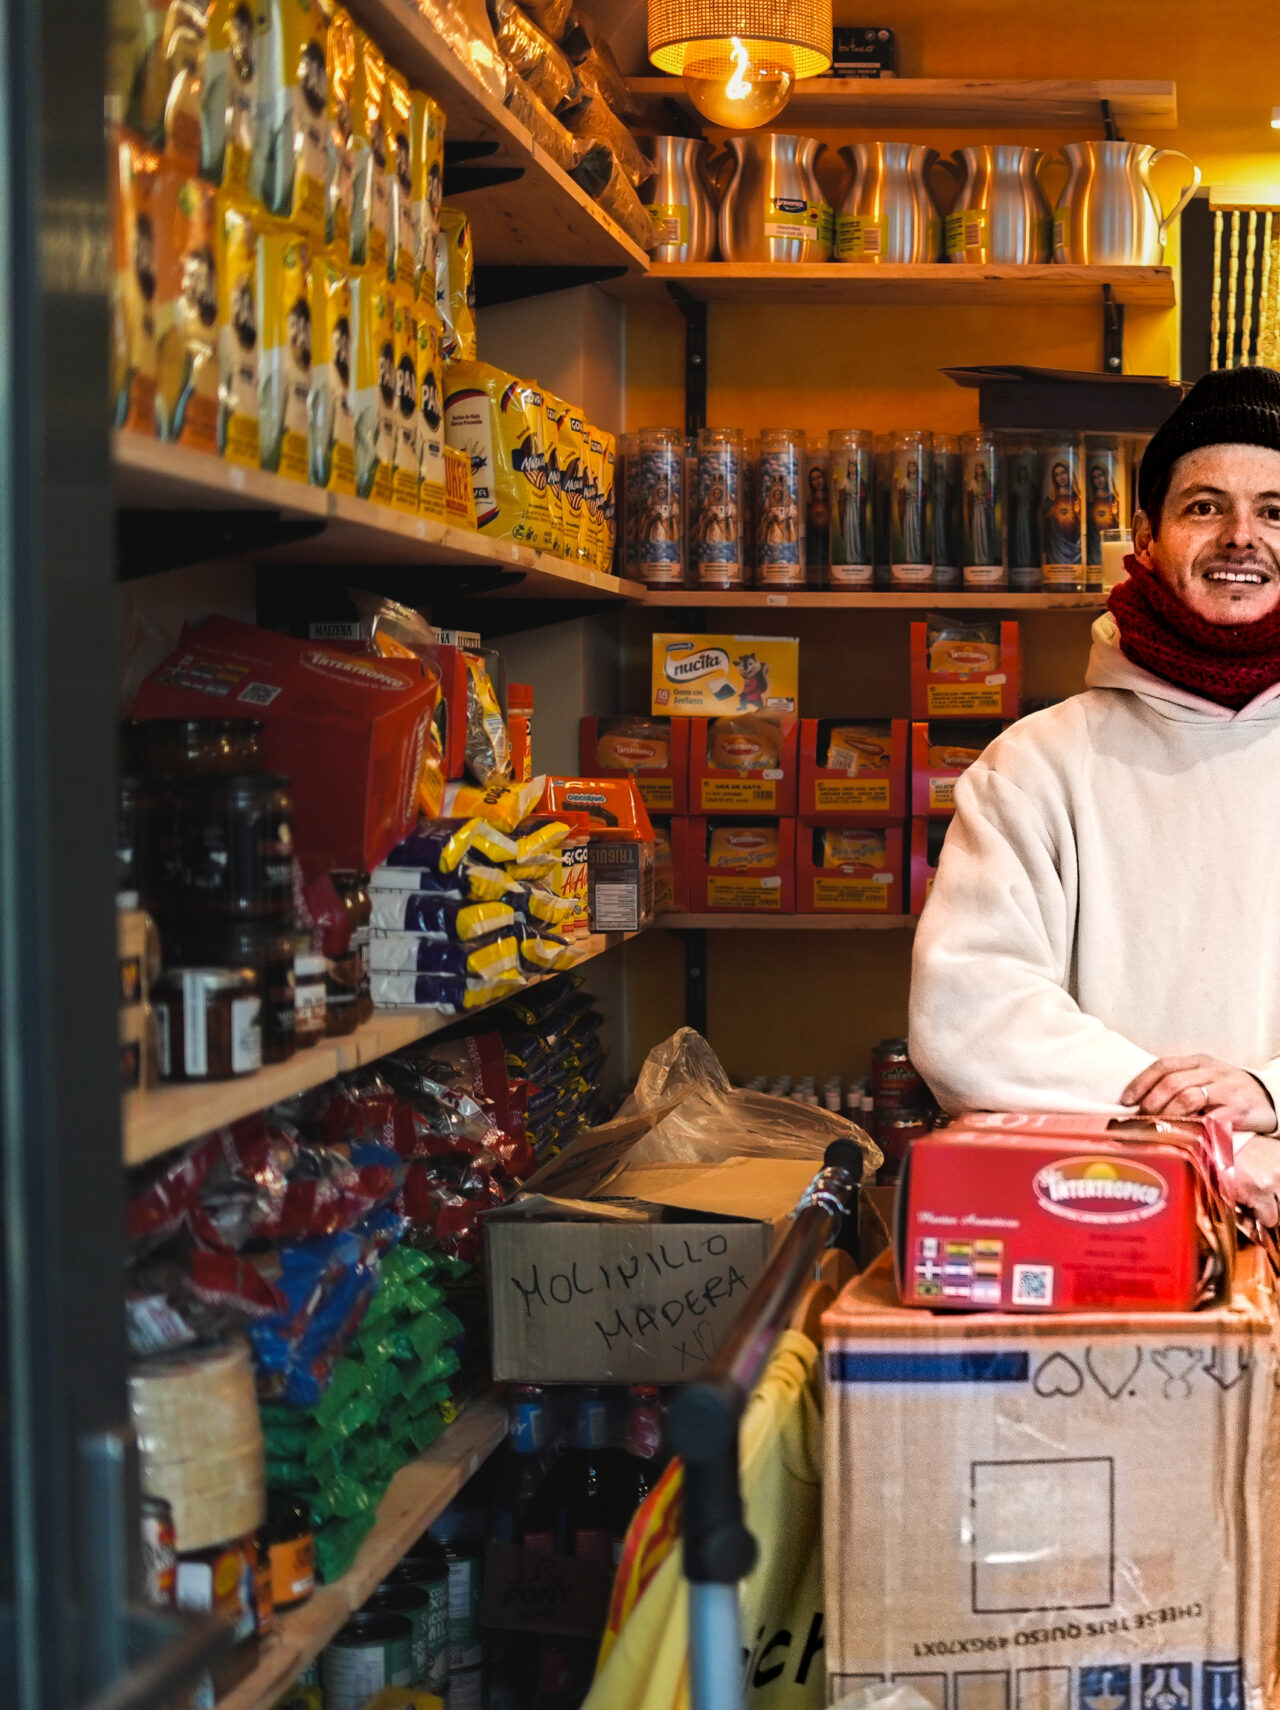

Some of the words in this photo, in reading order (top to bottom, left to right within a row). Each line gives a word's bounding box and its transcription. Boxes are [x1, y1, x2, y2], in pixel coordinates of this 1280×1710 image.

[674, 653, 722, 676] nucita
[511, 1235, 727, 1318] MOLINILLO
[595, 1266, 748, 1350] MADERA
[1134, 1602, 1202, 1630] CHEESE
[1014, 1623, 1082, 1647] QUESO
